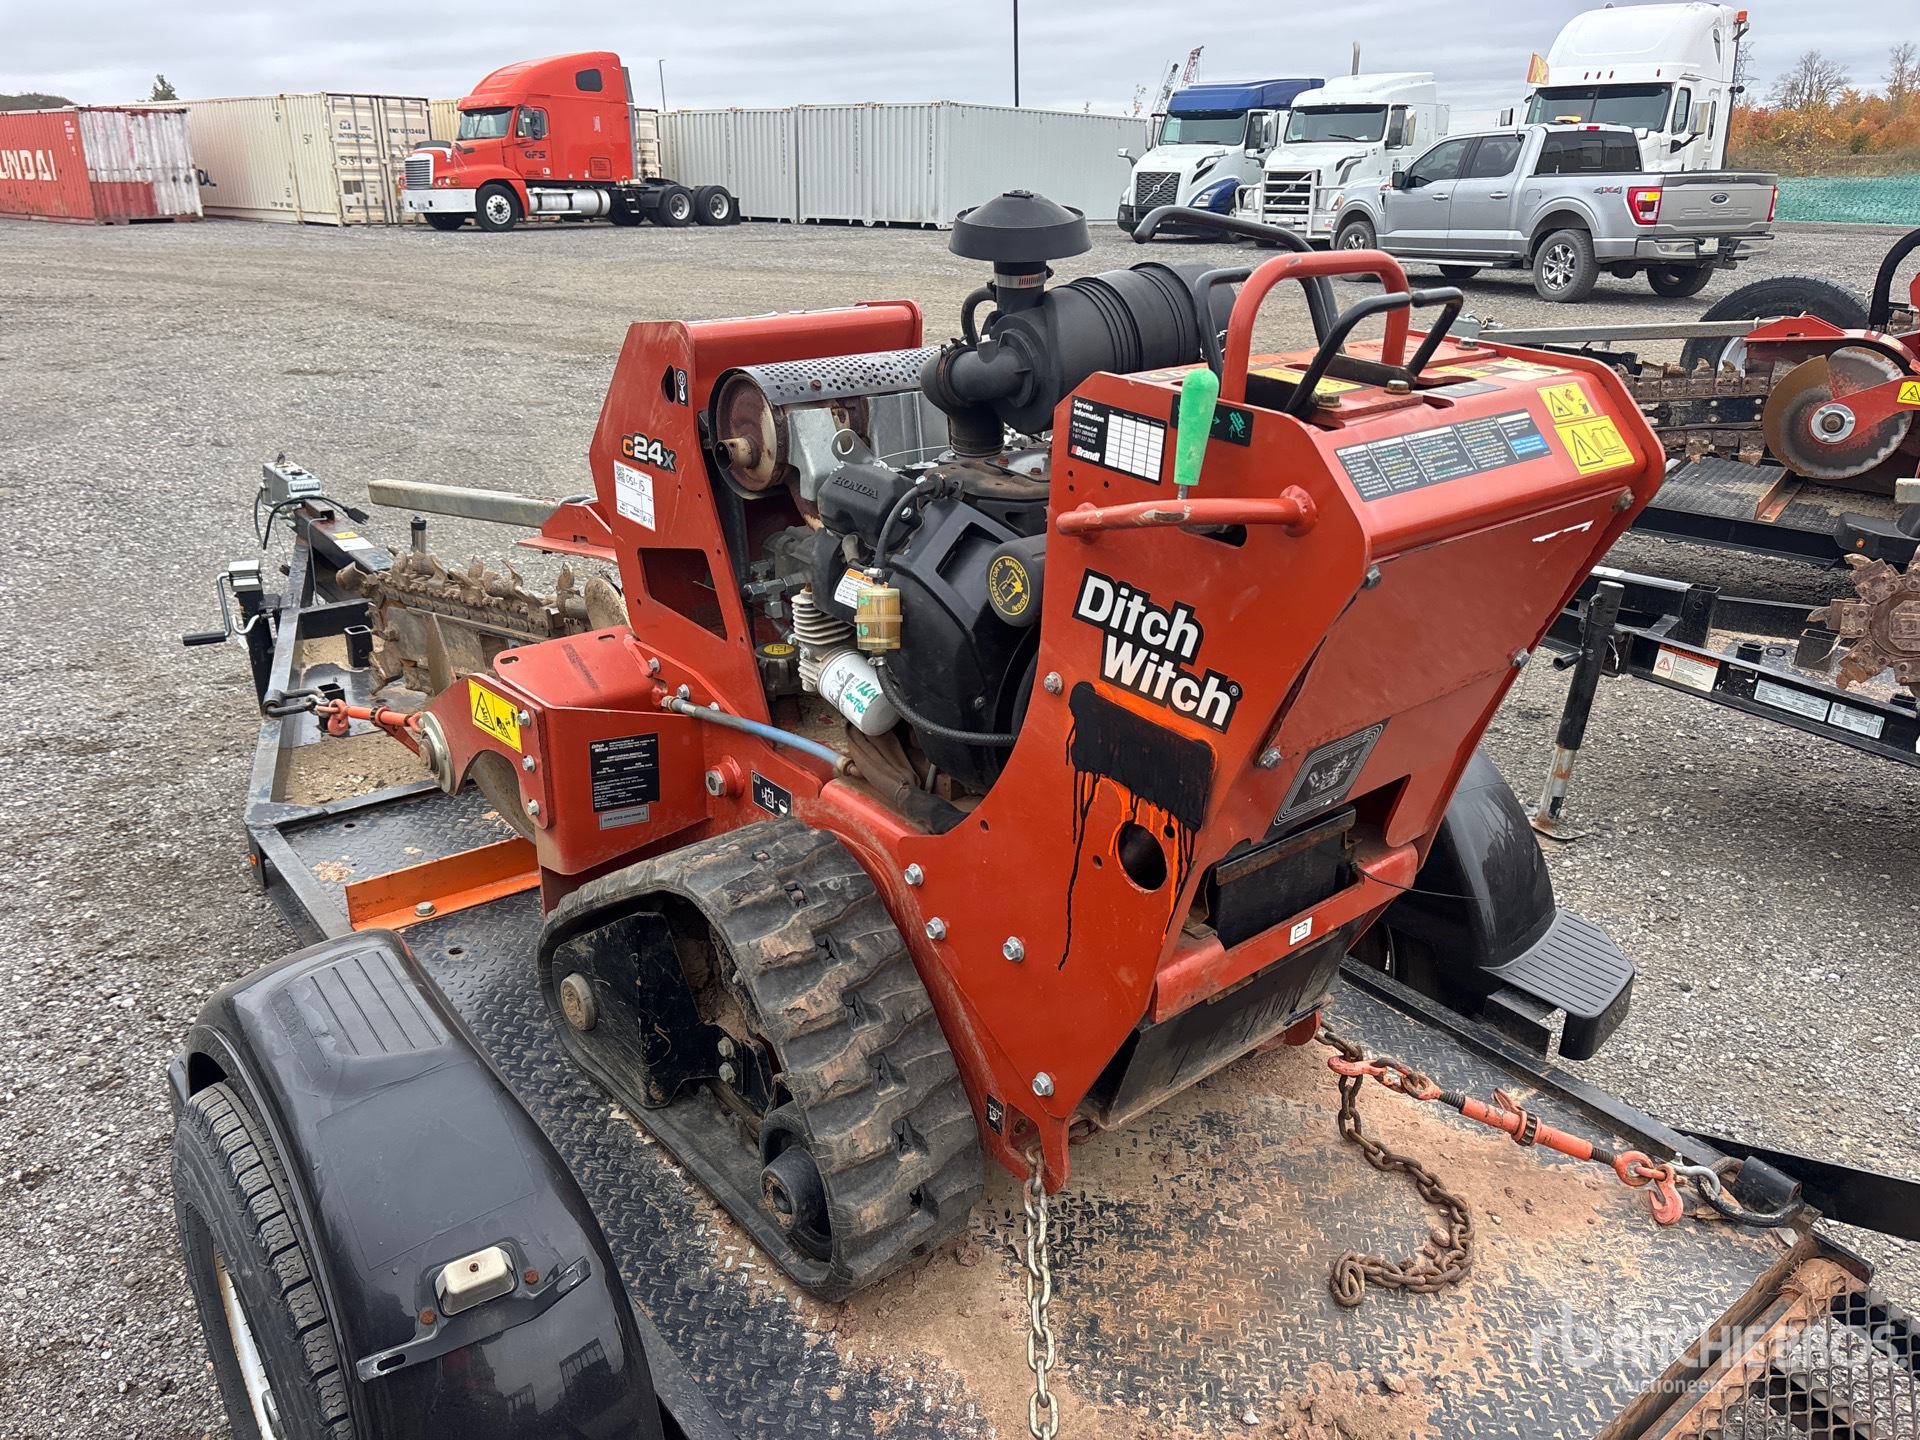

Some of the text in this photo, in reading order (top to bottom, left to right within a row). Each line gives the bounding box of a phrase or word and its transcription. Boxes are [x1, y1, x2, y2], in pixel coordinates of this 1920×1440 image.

[525, 150, 547, 159] GFS
[1073, 408, 1105, 423] Information
[1074, 399, 1094, 412] Service
[1075, 445, 1101, 462] Brandt
[832, 476, 879, 499] HONDA
[1004, 559, 1025, 580] MANUAL
[1011, 592, 1028, 612] INSIDE
[1078, 575, 1199, 658] Ditch
[1104, 634, 1232, 727] Witch
